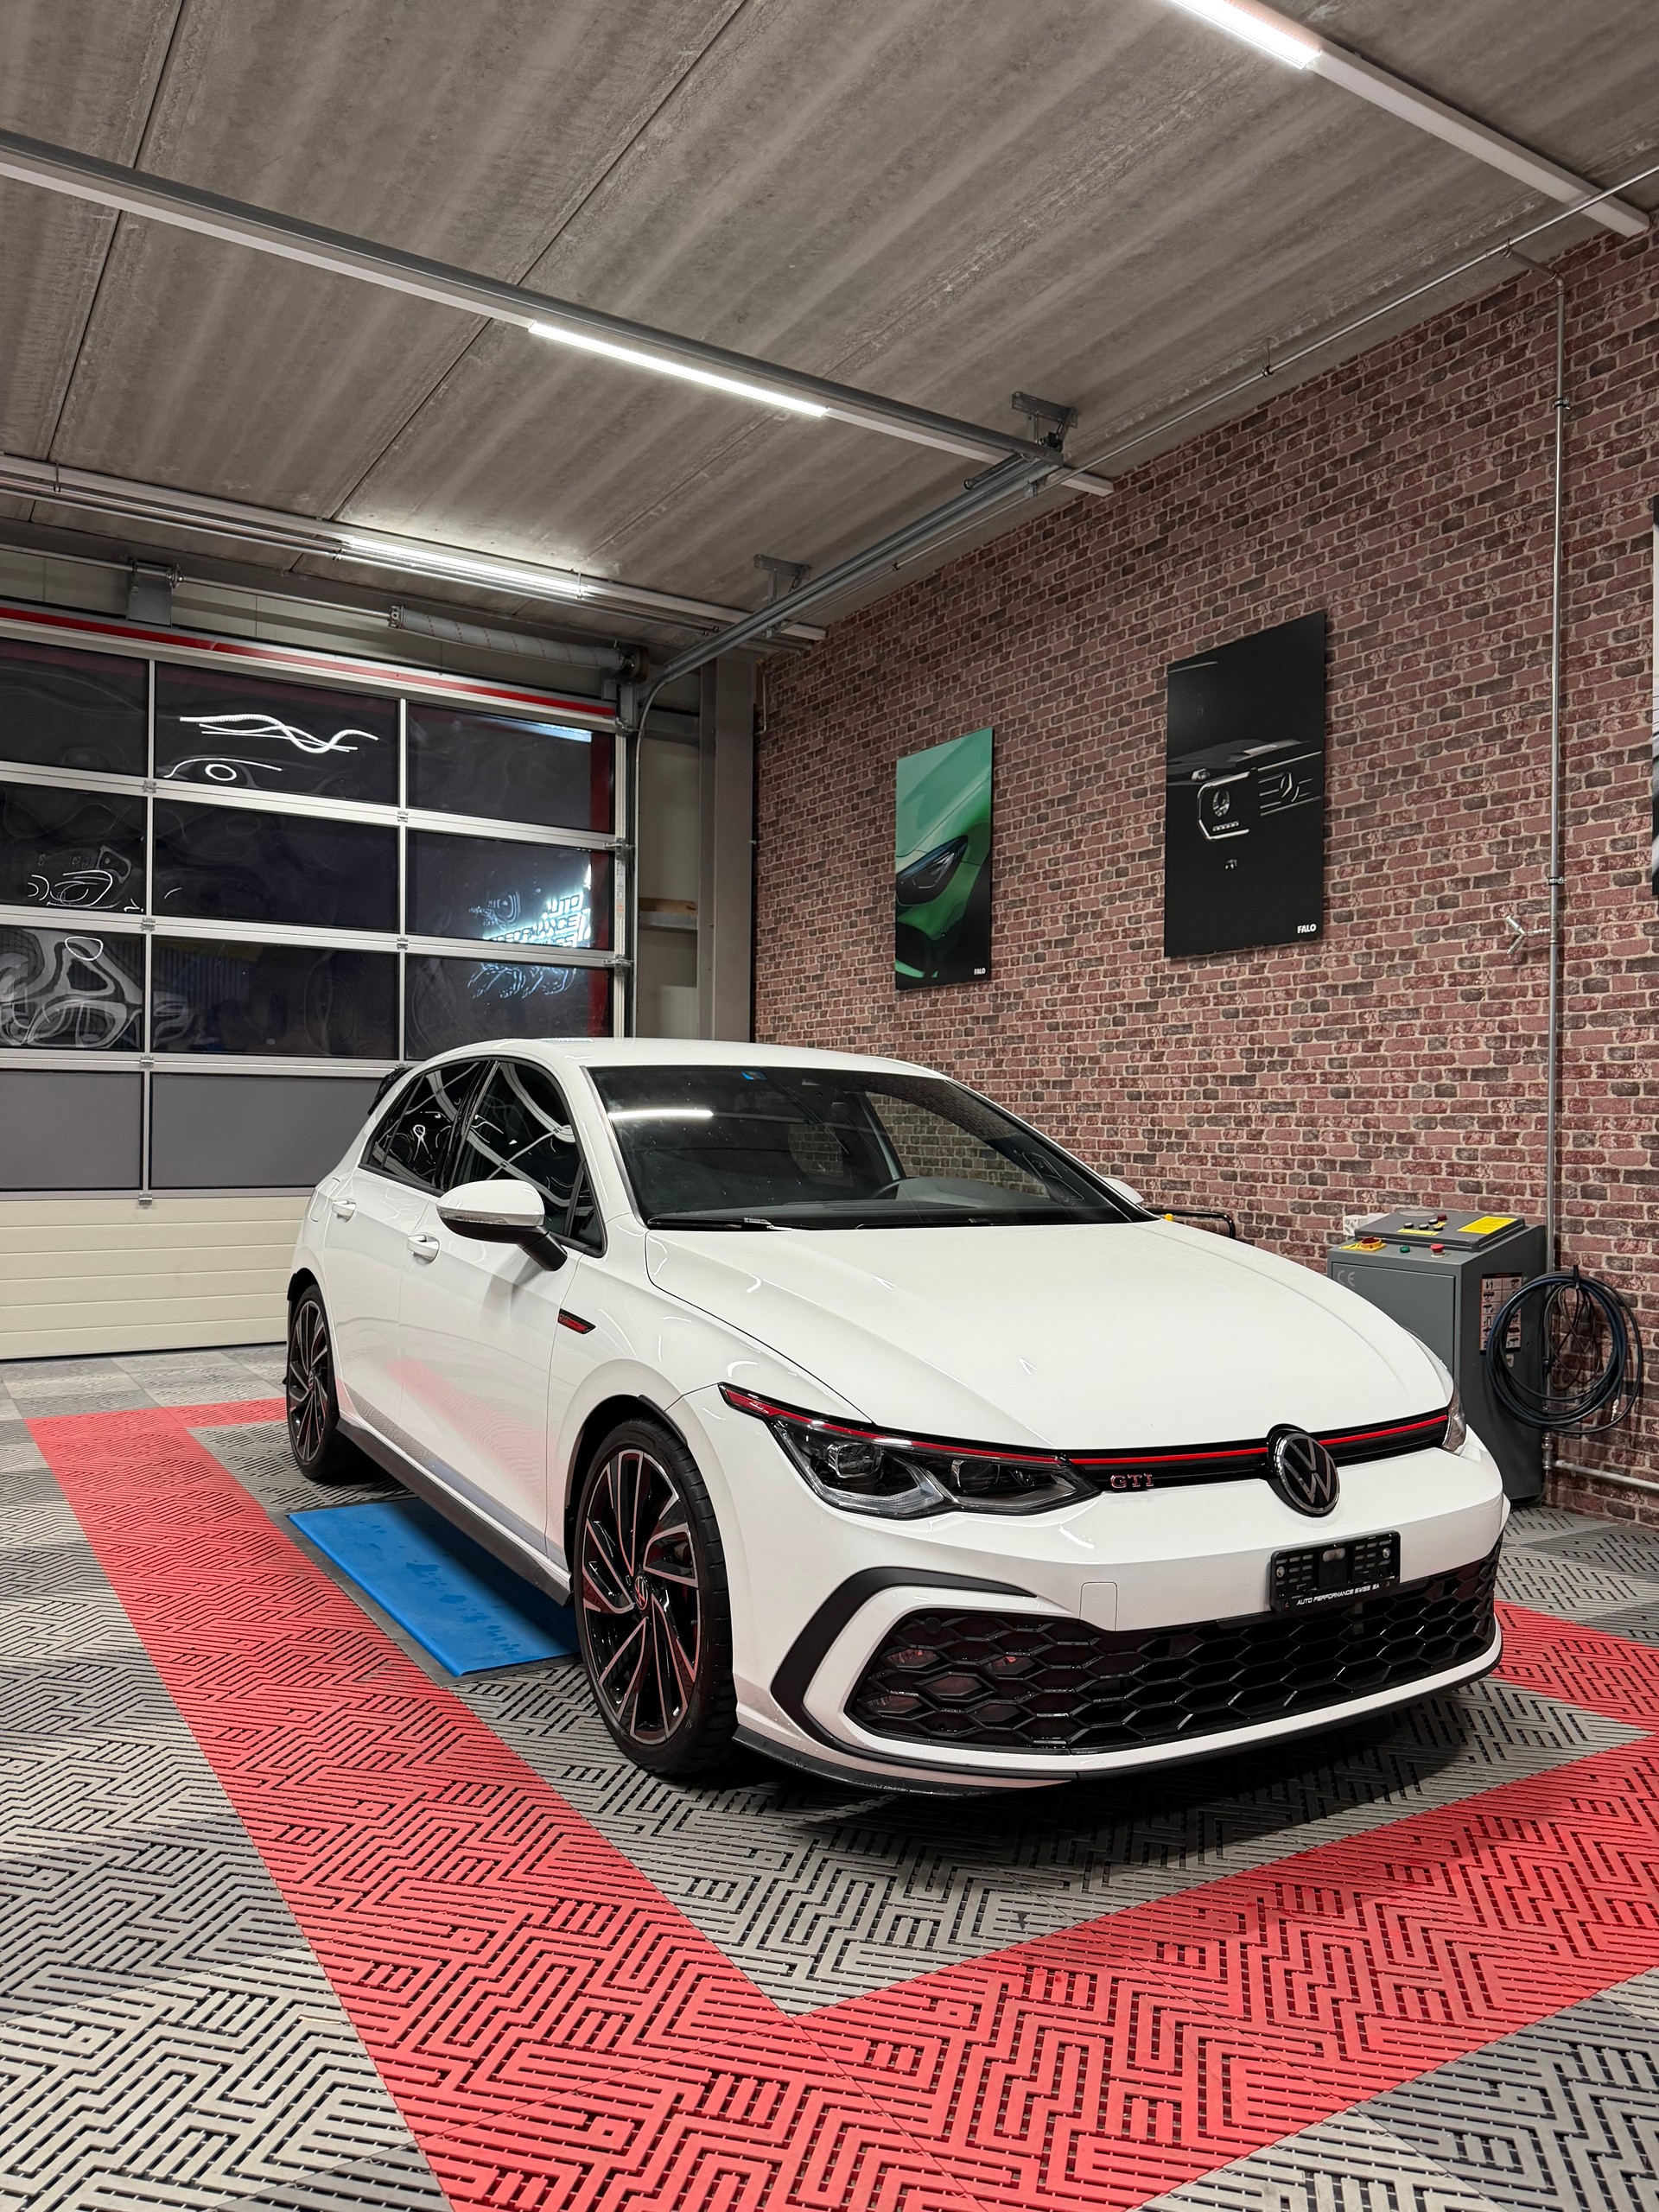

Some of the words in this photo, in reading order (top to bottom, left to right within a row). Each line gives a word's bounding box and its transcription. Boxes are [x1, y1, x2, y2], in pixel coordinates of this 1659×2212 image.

[1297, 924, 1317, 933] FALO
[1110, 1472, 1154, 1488] GTI
[1296, 1597, 1313, 1606] AUTO
[1313, 1588, 1354, 1602] PERFORMANCE
[1354, 1585, 1371, 1594] SWISS
